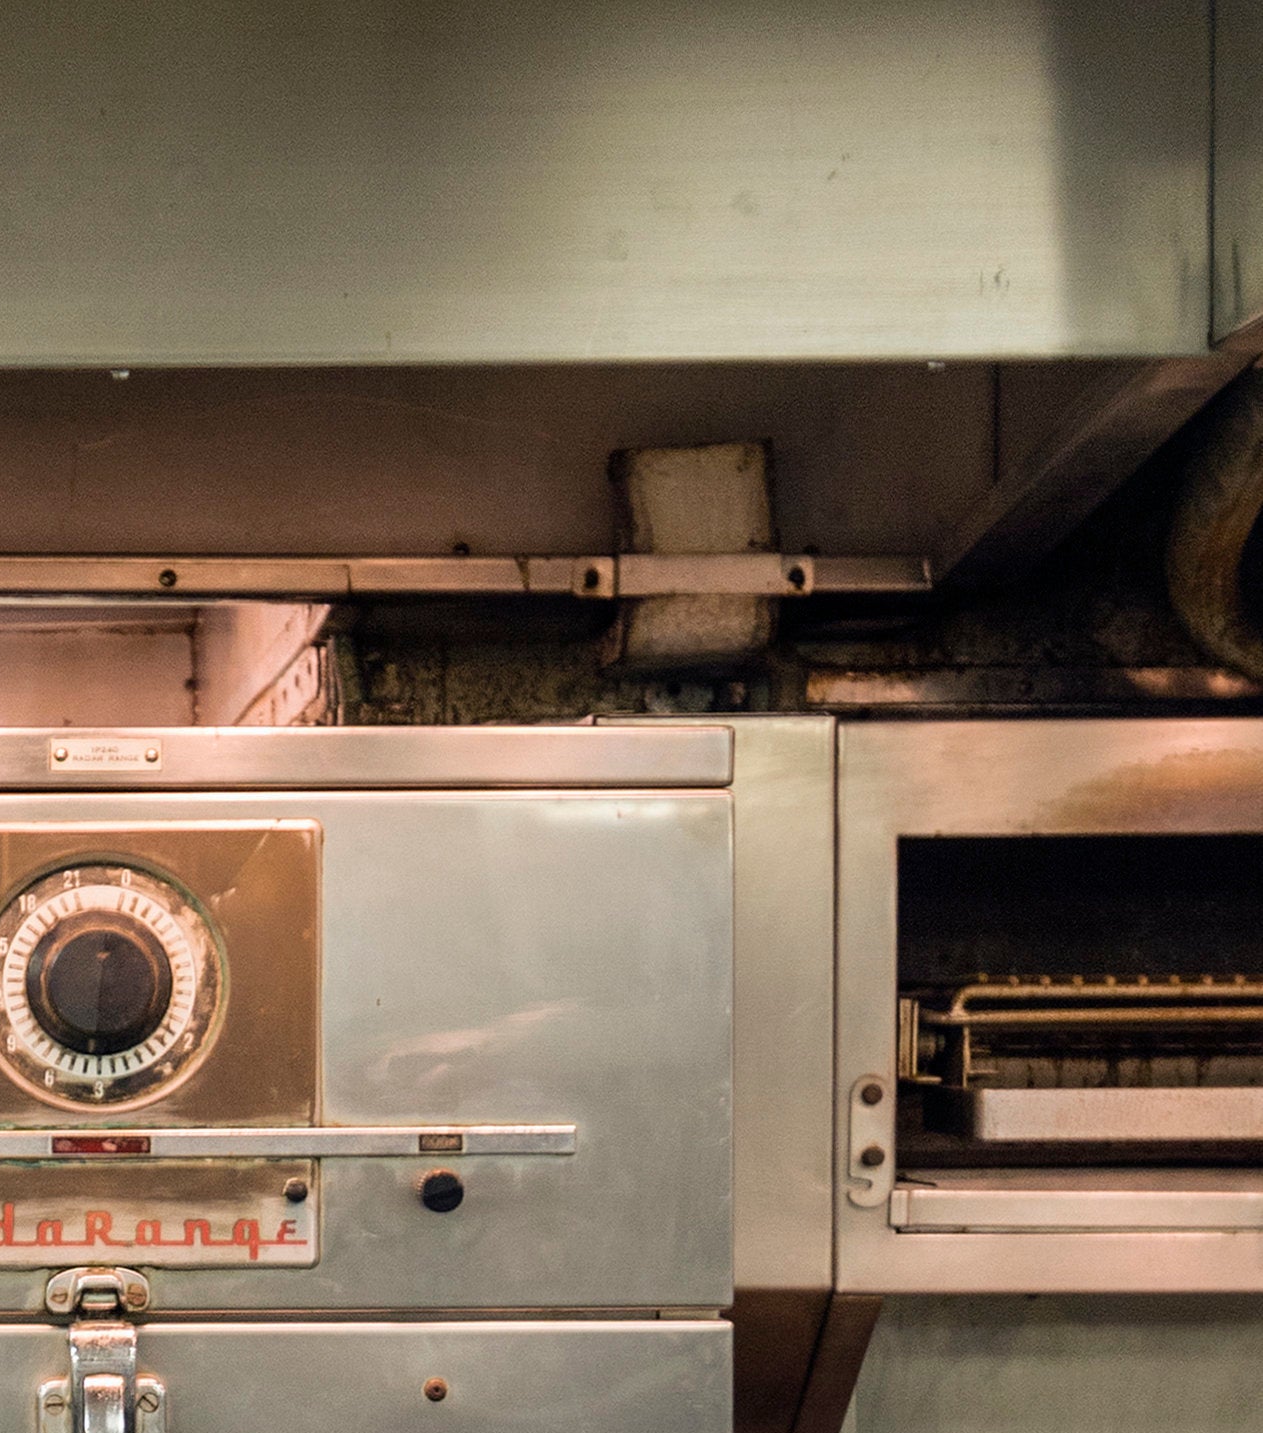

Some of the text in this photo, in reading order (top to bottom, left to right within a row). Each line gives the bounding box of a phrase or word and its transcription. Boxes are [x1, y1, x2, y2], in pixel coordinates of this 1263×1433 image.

[63, 871, 80, 887] 21
[121, 870, 131, 886] 0
[19, 894, 36, 911] 18
[6, 1035, 17, 1051] 9
[44, 1070, 55, 1087] 6
[94, 1080, 104, 1099] 3
